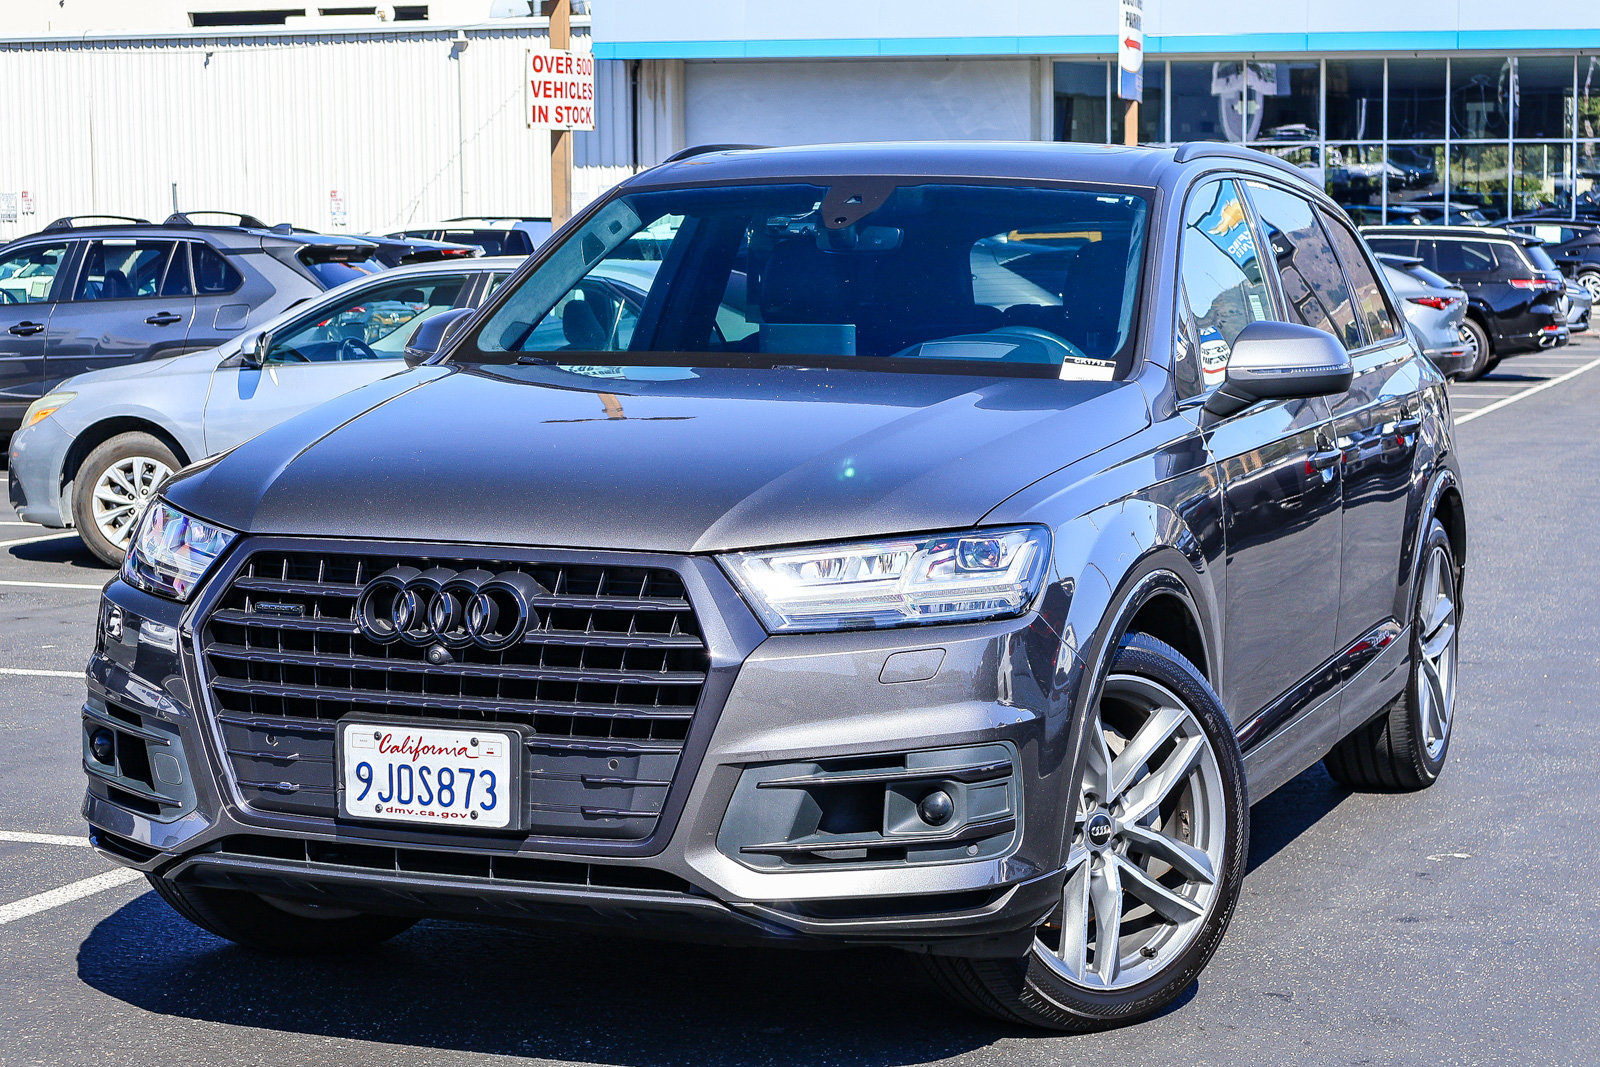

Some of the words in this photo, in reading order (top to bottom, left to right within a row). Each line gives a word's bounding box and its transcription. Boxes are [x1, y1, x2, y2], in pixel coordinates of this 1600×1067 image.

[532, 55, 573, 74] OVER
[576, 57, 592, 76] 500
[531, 80, 593, 100] VEHICLES
[532, 105, 548, 123] IN
[555, 105, 592, 124] STOCK
[379, 733, 479, 762] California
[385, 806, 468, 819] dmv.ca.gov
